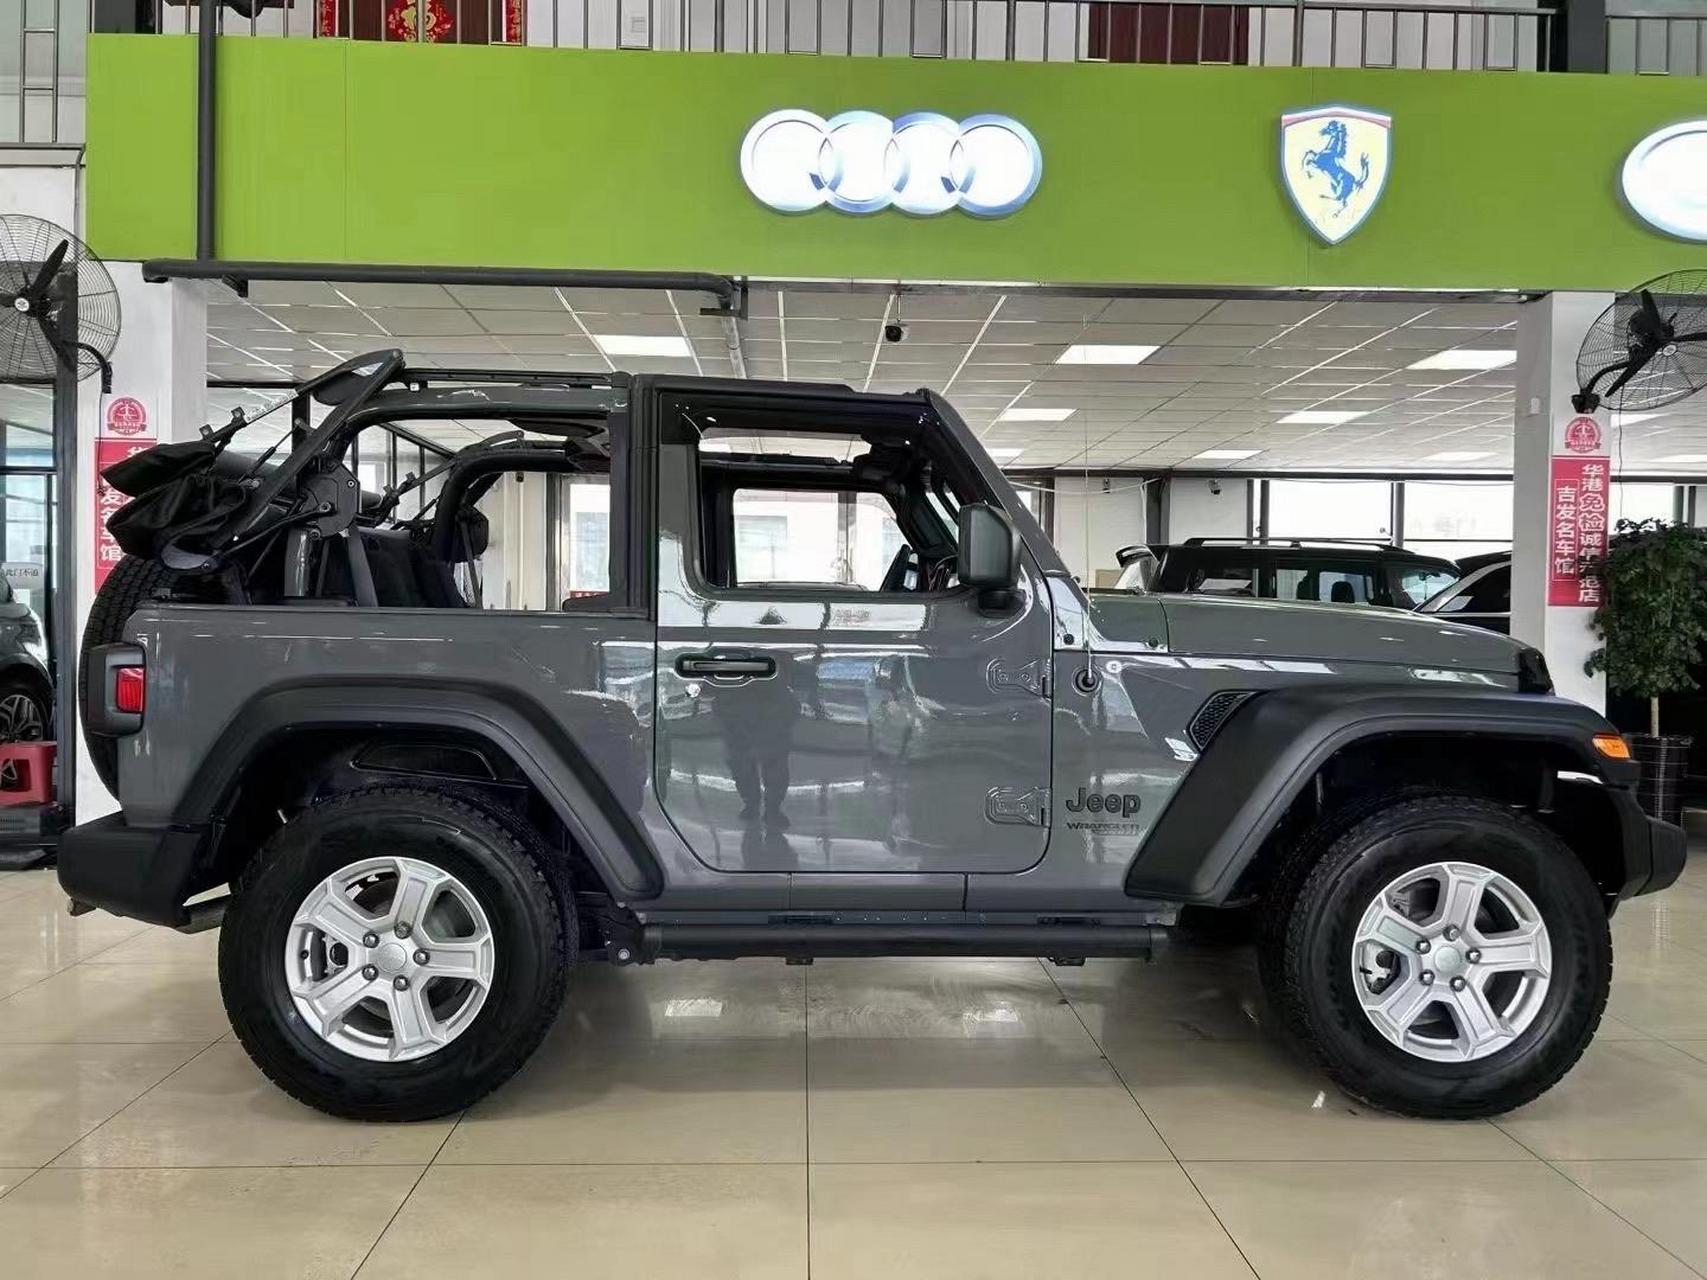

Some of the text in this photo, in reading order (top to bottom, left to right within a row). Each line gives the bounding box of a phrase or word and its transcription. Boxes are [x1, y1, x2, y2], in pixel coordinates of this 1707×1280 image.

[1555, 486, 1577, 574] 吉发名车馆
[1066, 787, 1141, 818] Jeep
